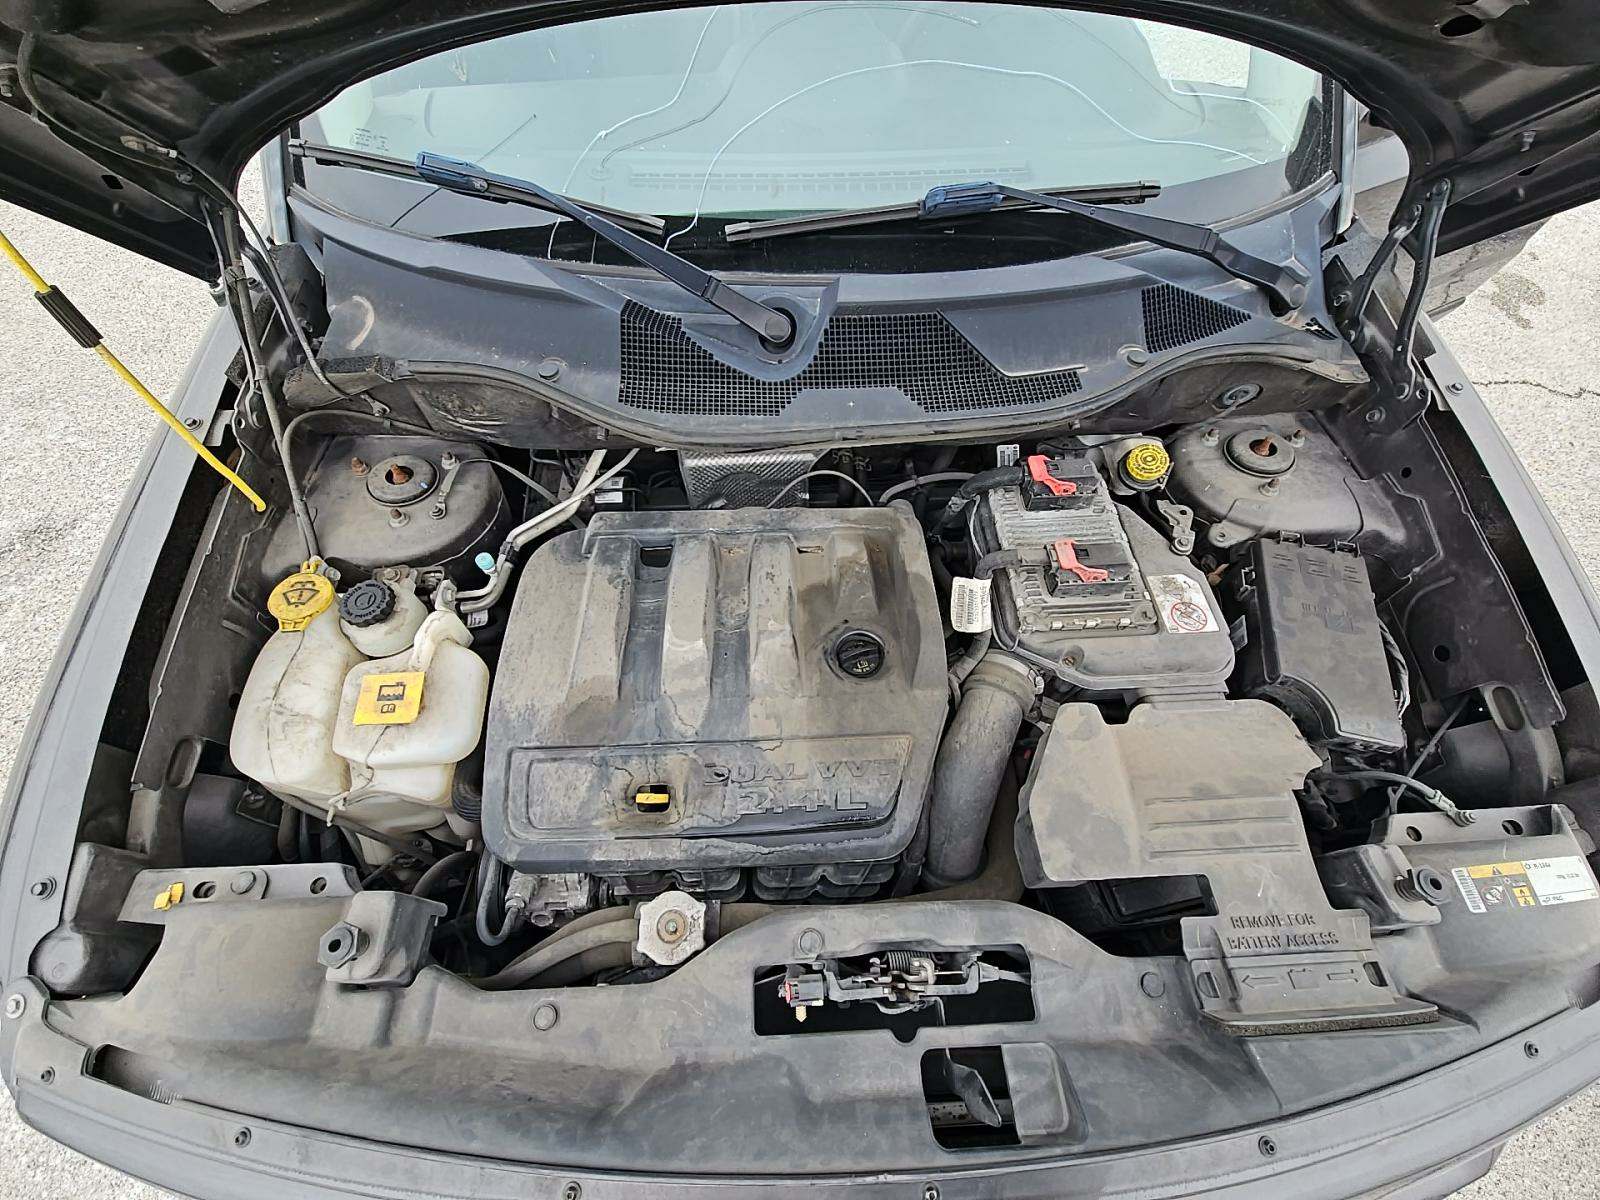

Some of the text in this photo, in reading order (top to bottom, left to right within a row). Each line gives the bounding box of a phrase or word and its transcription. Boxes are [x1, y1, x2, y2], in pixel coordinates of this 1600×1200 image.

[1230, 912, 1317, 929] REMOVE FOR
[1226, 931, 1340, 950] BATTERY ACCESS
